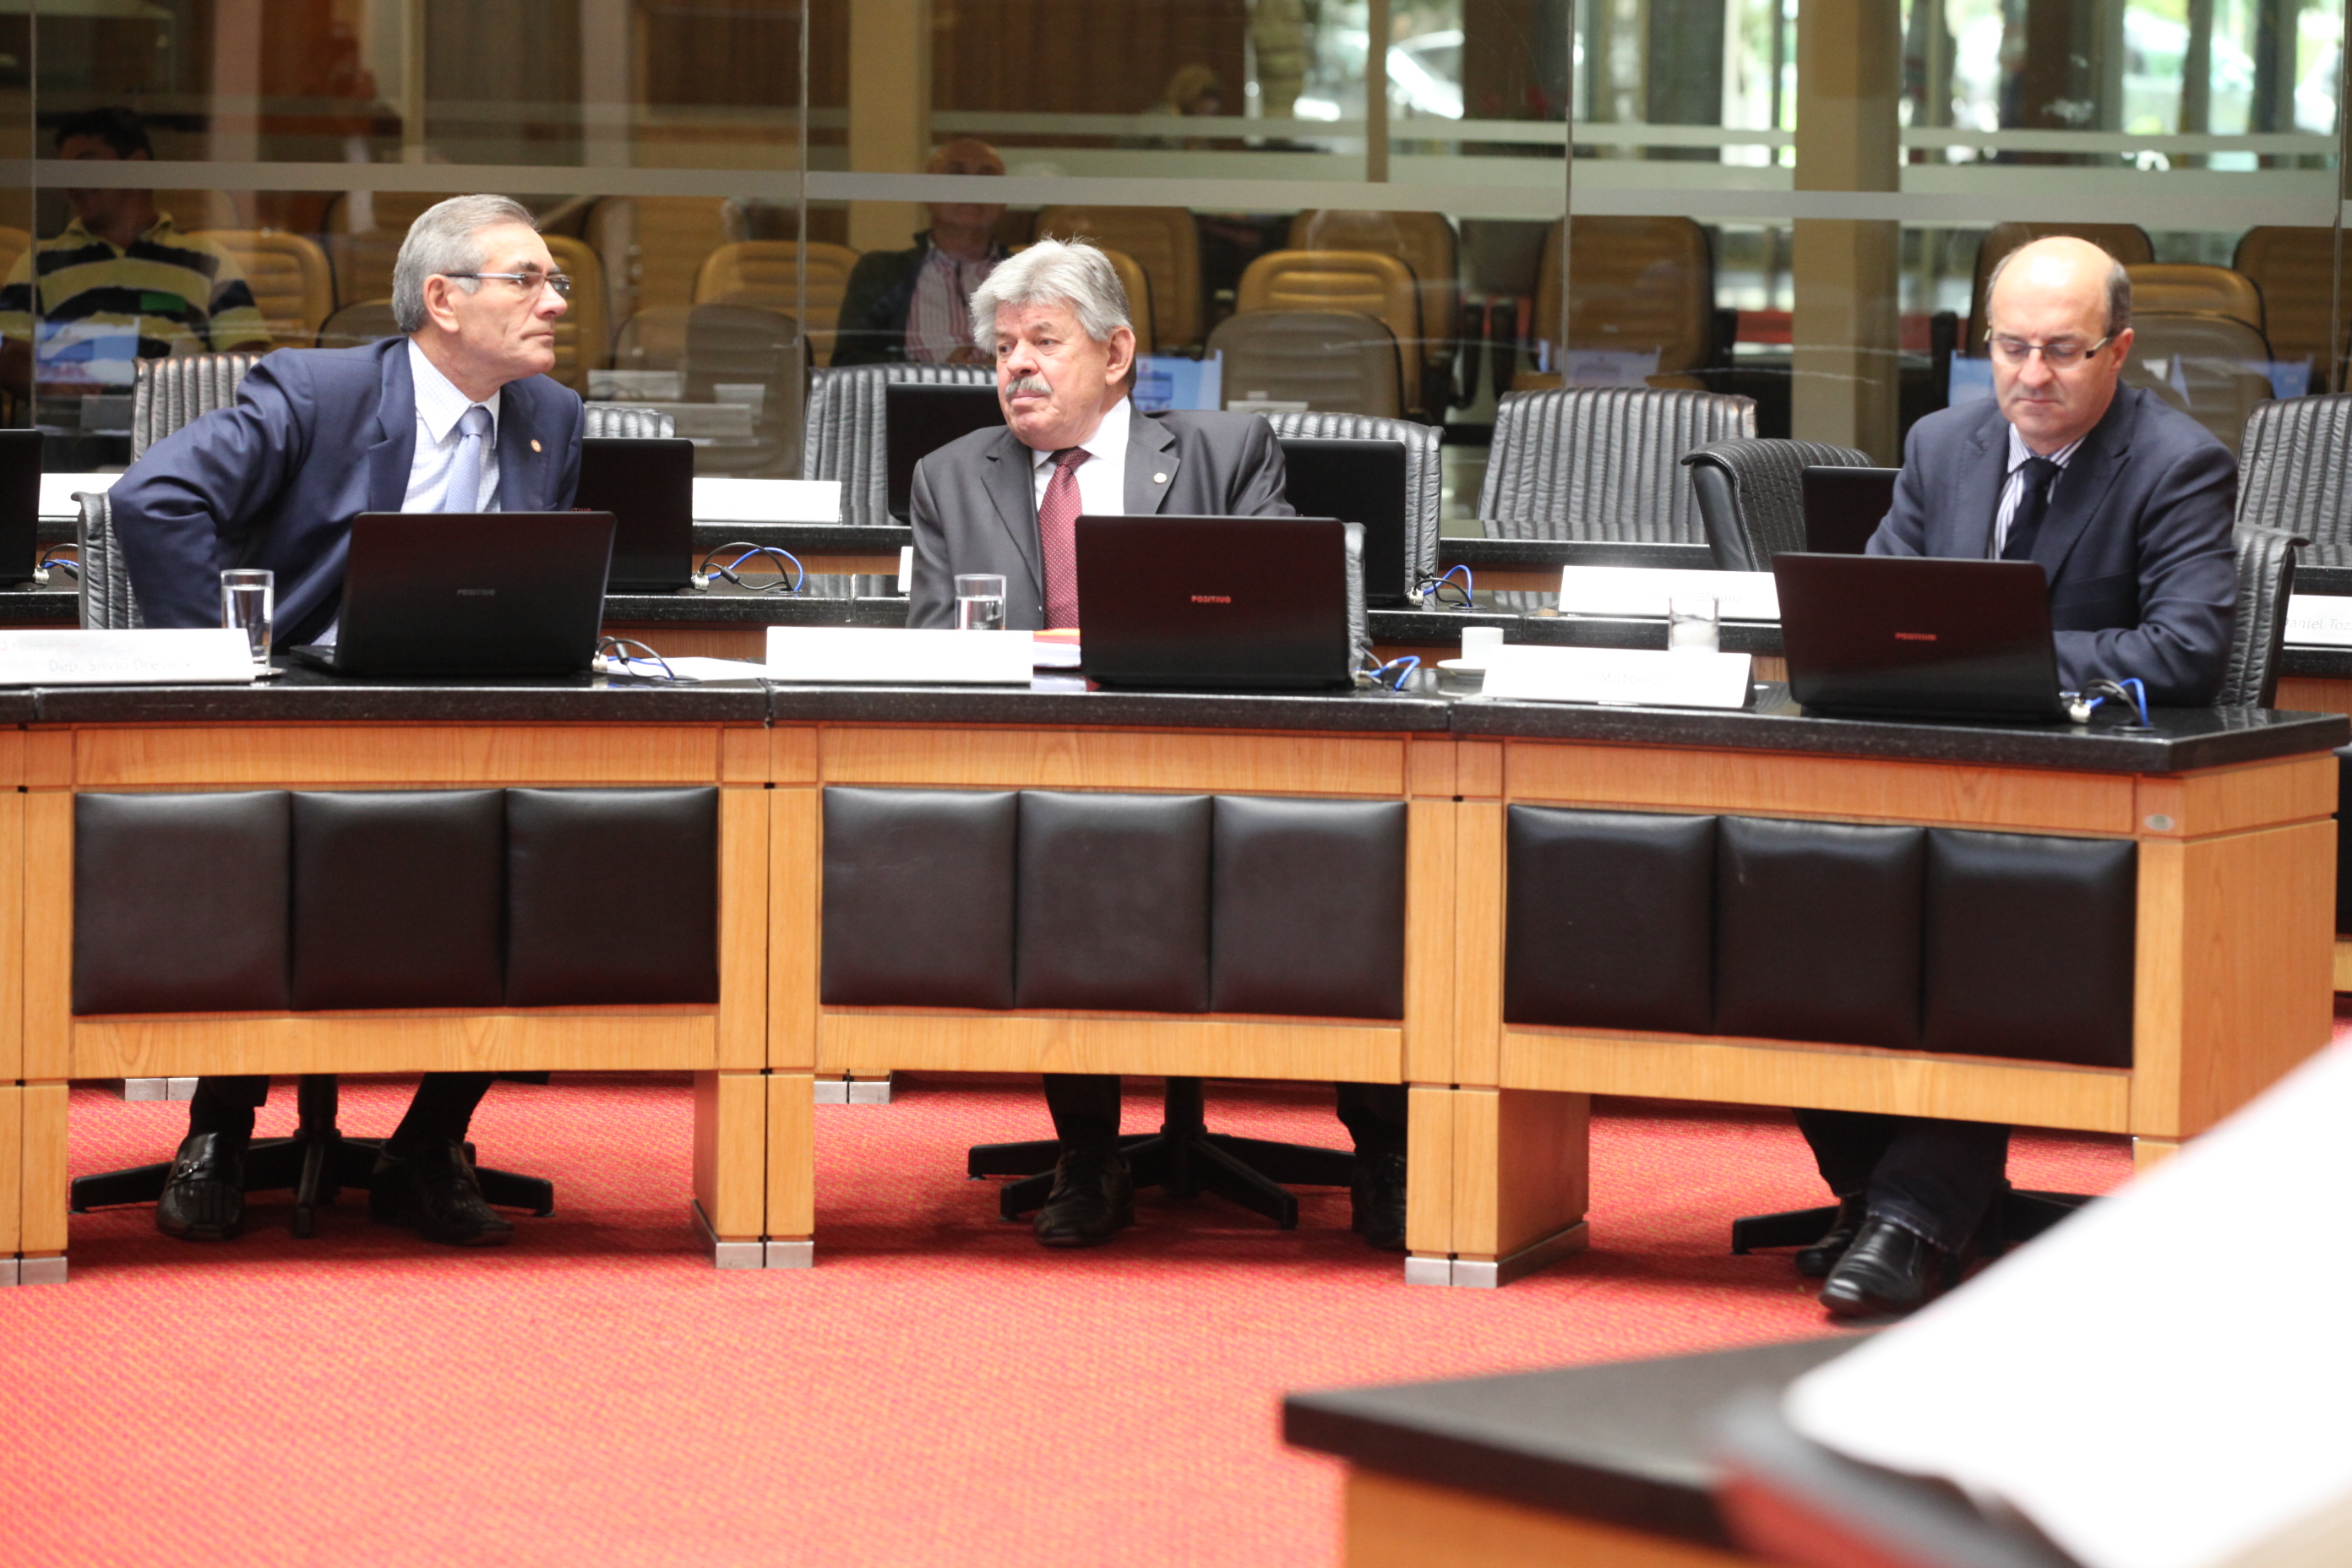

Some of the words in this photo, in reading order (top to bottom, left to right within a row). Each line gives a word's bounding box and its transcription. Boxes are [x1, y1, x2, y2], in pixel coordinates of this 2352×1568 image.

[1191, 595, 1231, 603] POSITIVO
[2285, 618, 2322, 629] aniel
[48, 659, 83, 675] Dep.
[88, 658, 128, 672] Silvio
